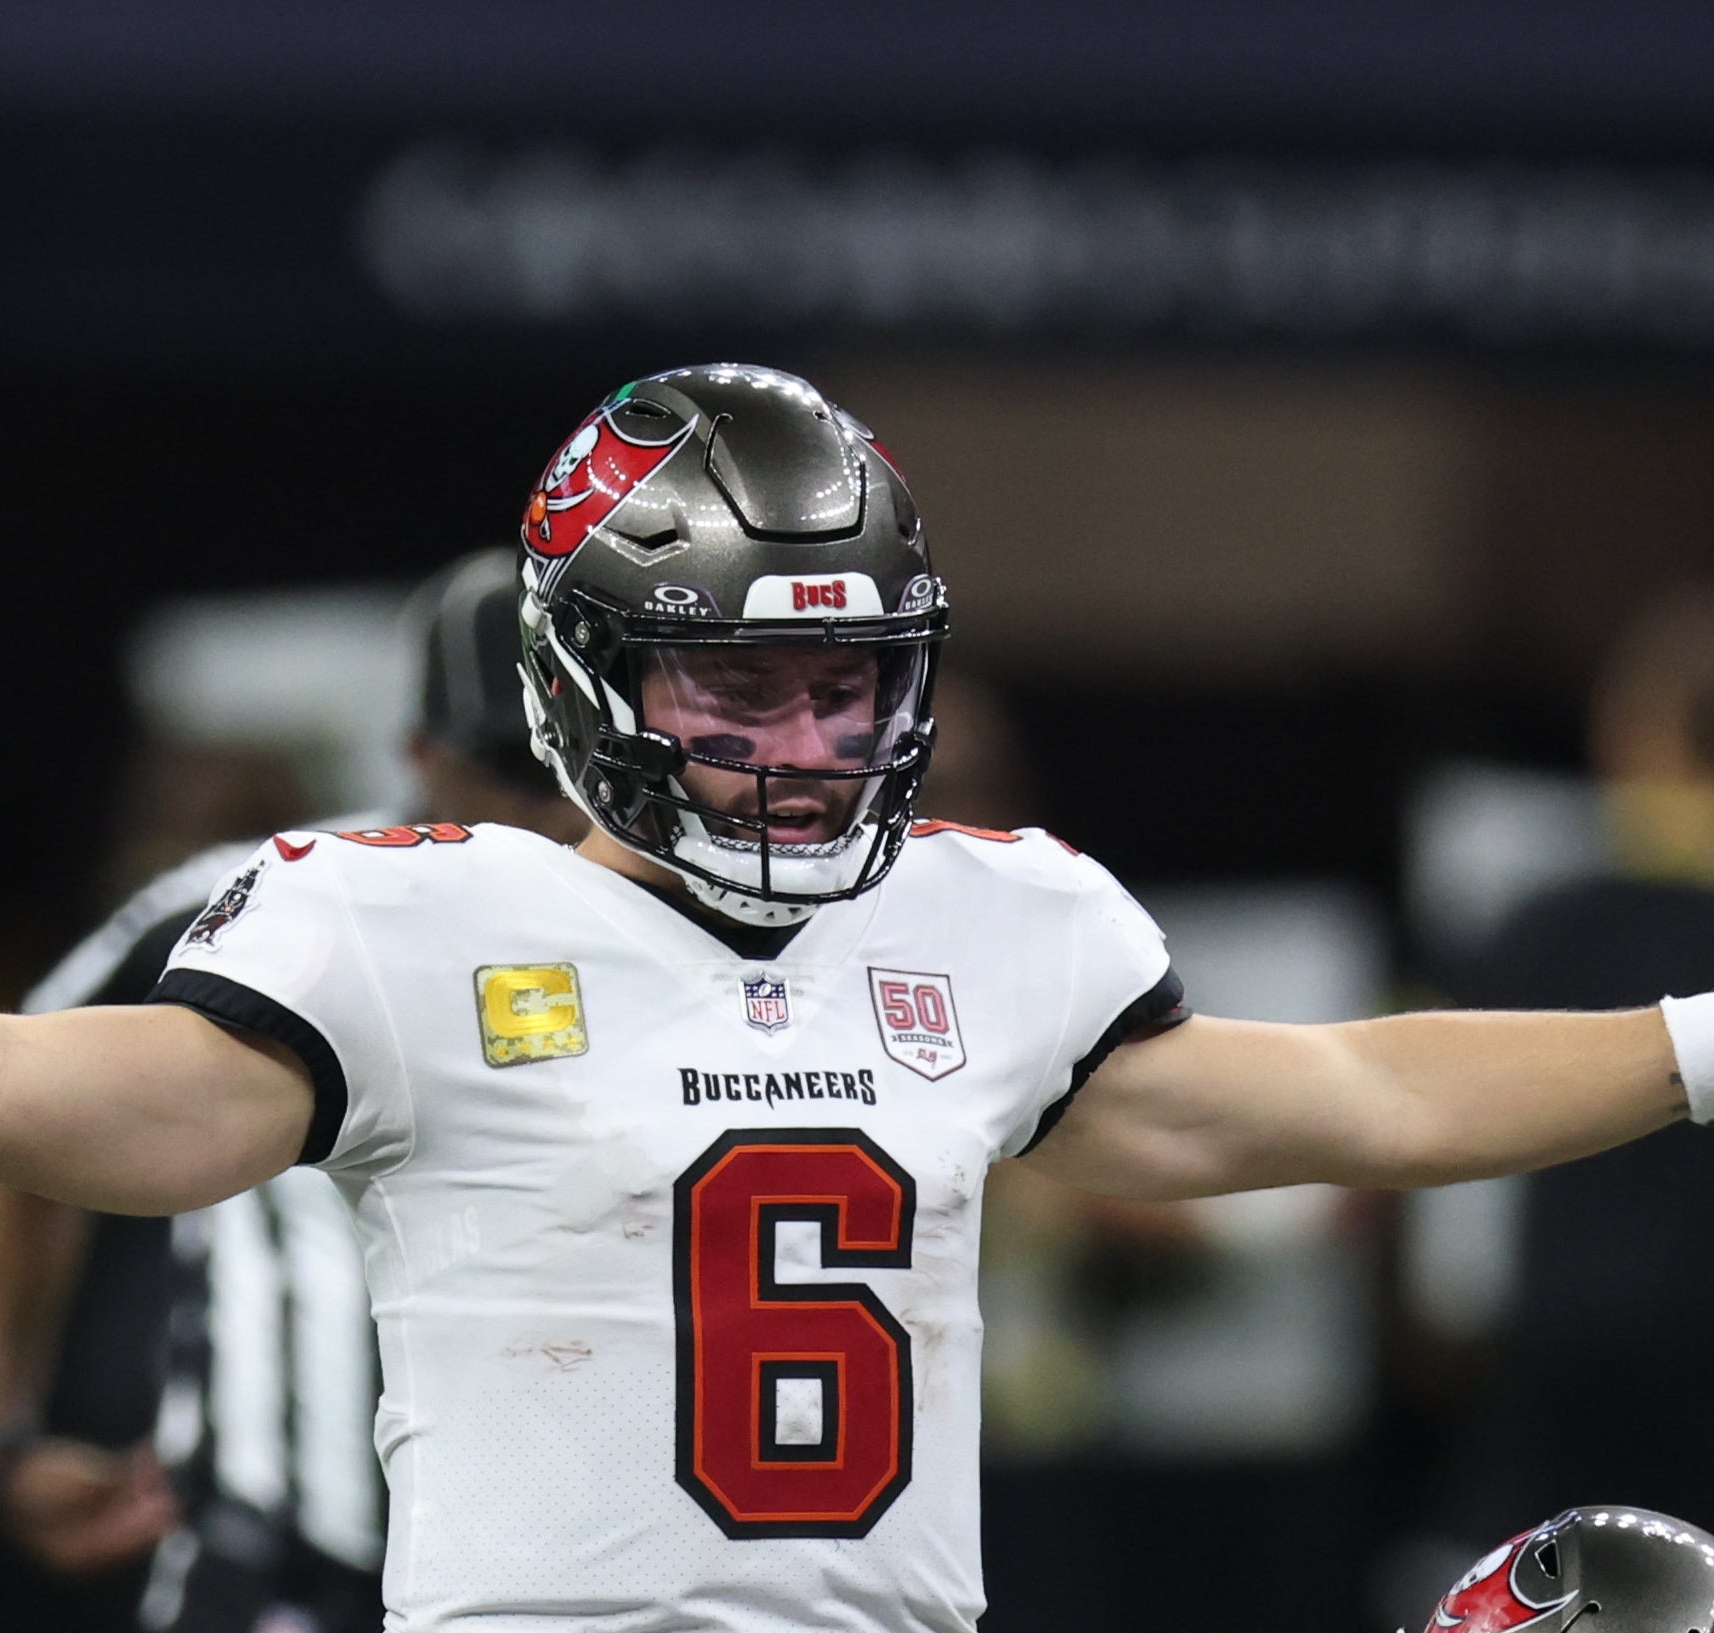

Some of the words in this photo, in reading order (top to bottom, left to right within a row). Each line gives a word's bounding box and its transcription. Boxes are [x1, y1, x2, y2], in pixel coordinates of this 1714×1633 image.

[644, 601, 708, 617] OAKLEY
[791, 580, 847, 611] BUCS
[485, 969, 576, 1038] C
[750, 1000, 785, 1022] NFL
[879, 980, 950, 1035] 50
[677, 1068, 877, 1110] BUCCANEERS
[673, 1128, 917, 1540] 6
